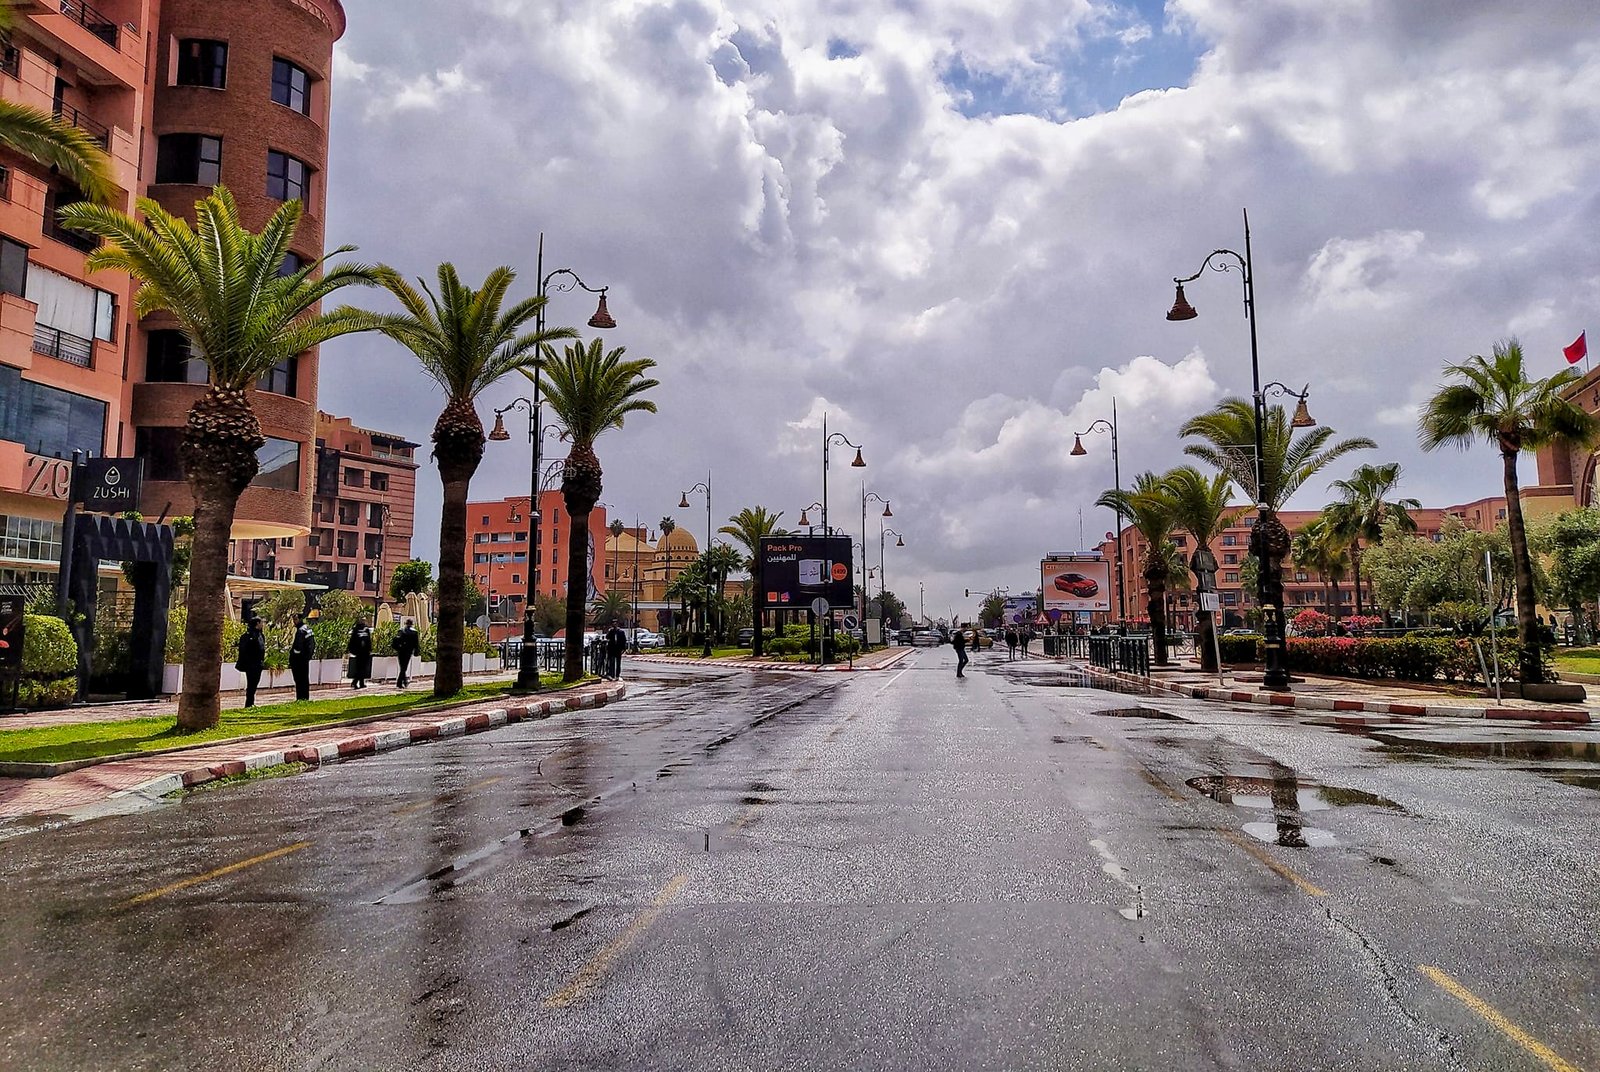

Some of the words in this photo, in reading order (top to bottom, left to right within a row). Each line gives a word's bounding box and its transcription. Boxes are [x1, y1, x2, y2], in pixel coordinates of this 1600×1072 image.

[93, 486, 130, 499] ZUSHI
[767, 544, 787, 552] Pack
[788, 544, 803, 552] Pro
[767, 553, 797, 563] للمهنيين
